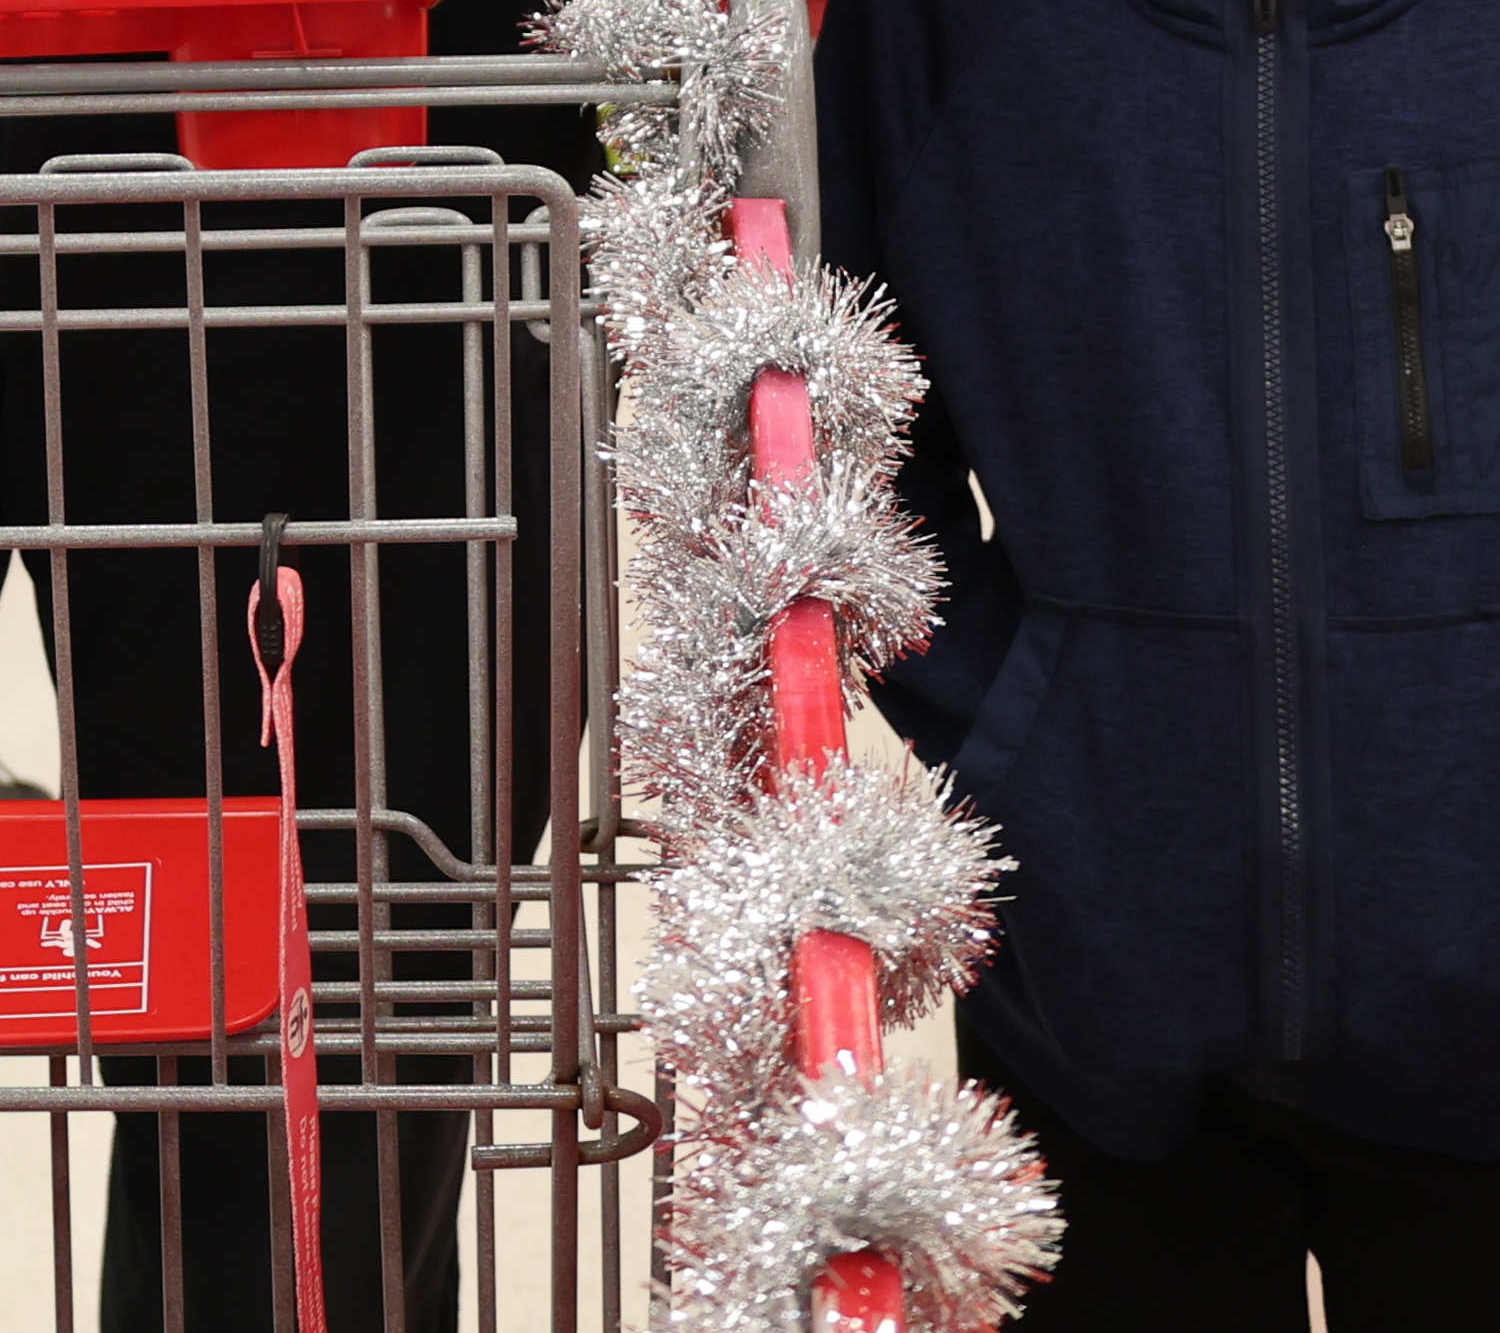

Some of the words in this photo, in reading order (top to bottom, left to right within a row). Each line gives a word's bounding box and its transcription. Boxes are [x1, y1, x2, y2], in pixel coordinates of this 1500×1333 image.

[45, 879, 85, 888] NLY
[107, 899, 135, 907] child
[10, 973, 38, 981] can
[300, 1115, 307, 1148] Do
[308, 1115, 317, 1191] Please
[300, 1156, 309, 1192] not
[303, 1196, 311, 1263] Leave
